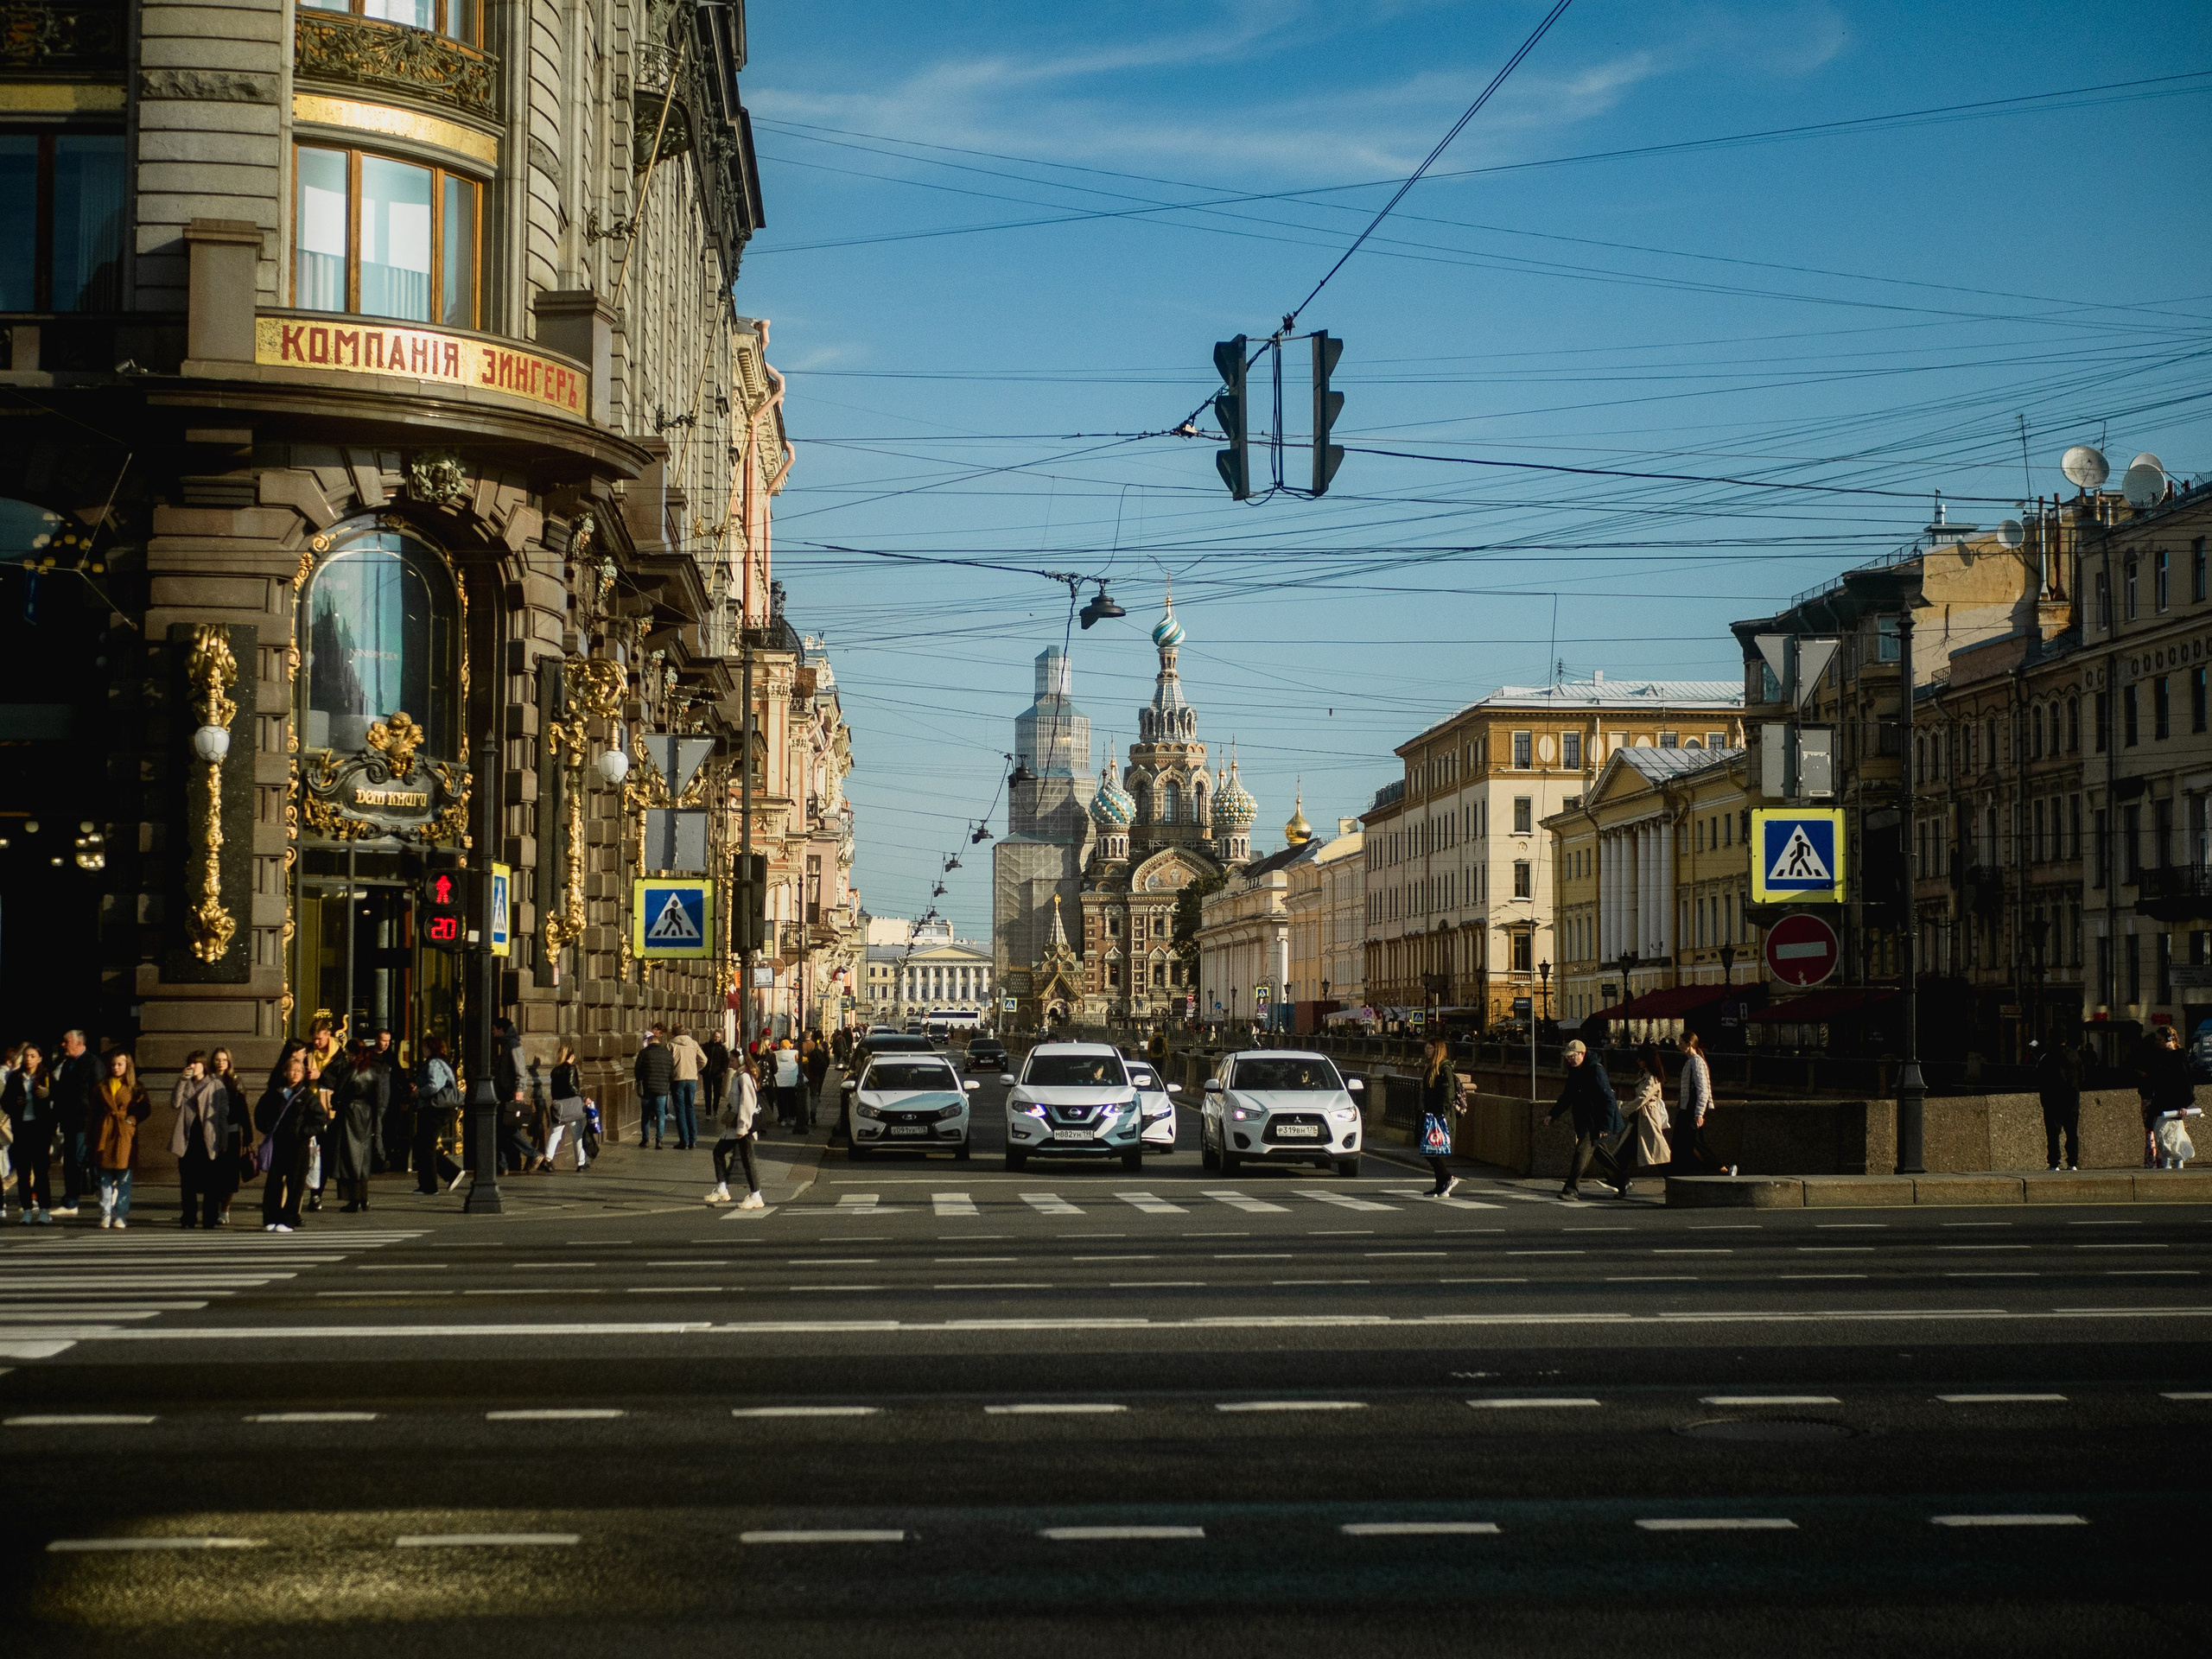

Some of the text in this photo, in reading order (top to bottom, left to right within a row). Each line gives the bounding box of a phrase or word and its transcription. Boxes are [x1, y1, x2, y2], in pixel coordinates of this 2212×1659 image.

[282, 324, 577, 409] КОМПАНІЯ ЗИНГЕРЪ
[431, 917, 457, 939] 20
